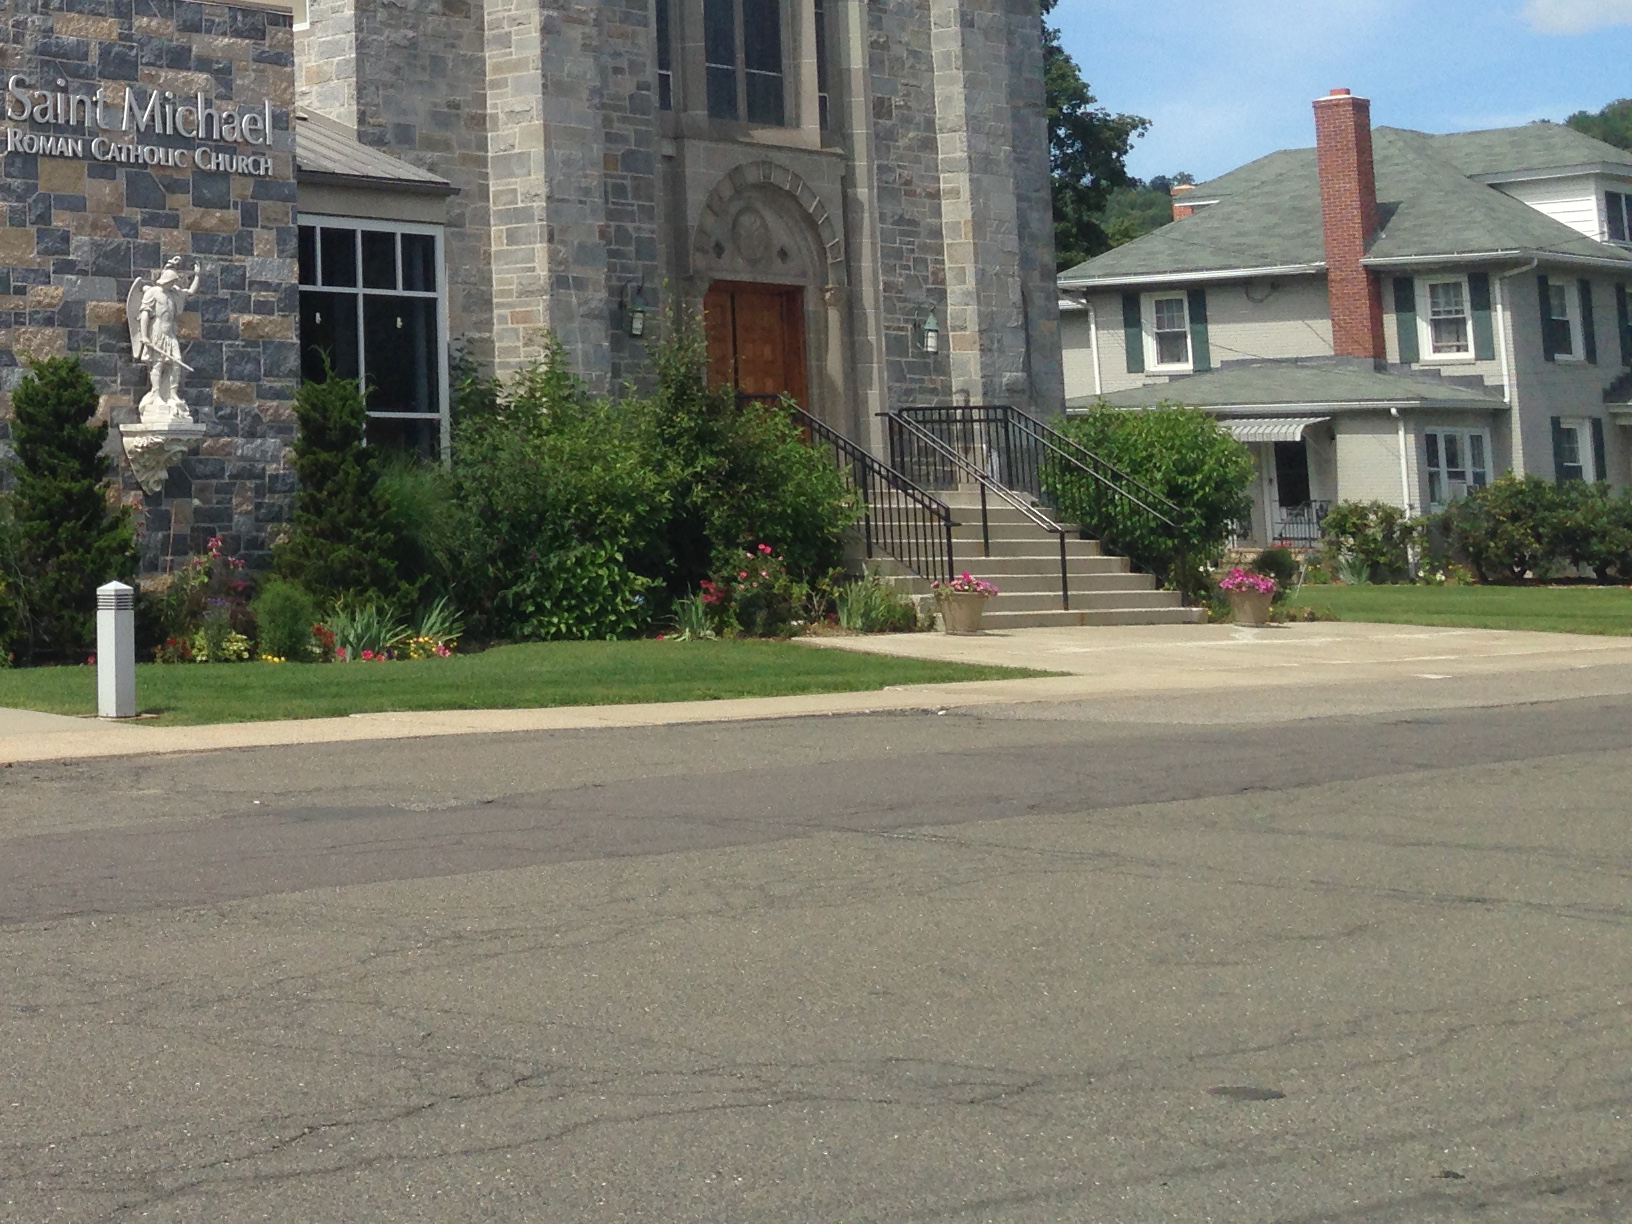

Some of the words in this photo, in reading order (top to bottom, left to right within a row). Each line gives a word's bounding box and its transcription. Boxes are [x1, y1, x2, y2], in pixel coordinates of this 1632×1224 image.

[7, 75, 111, 129] Saint
[122, 86, 273, 145] Michael
[7, 128, 84, 158] ROMAN
[91, 137, 188, 168] CATHOLIC
[195, 147, 273, 175] CHURCH
